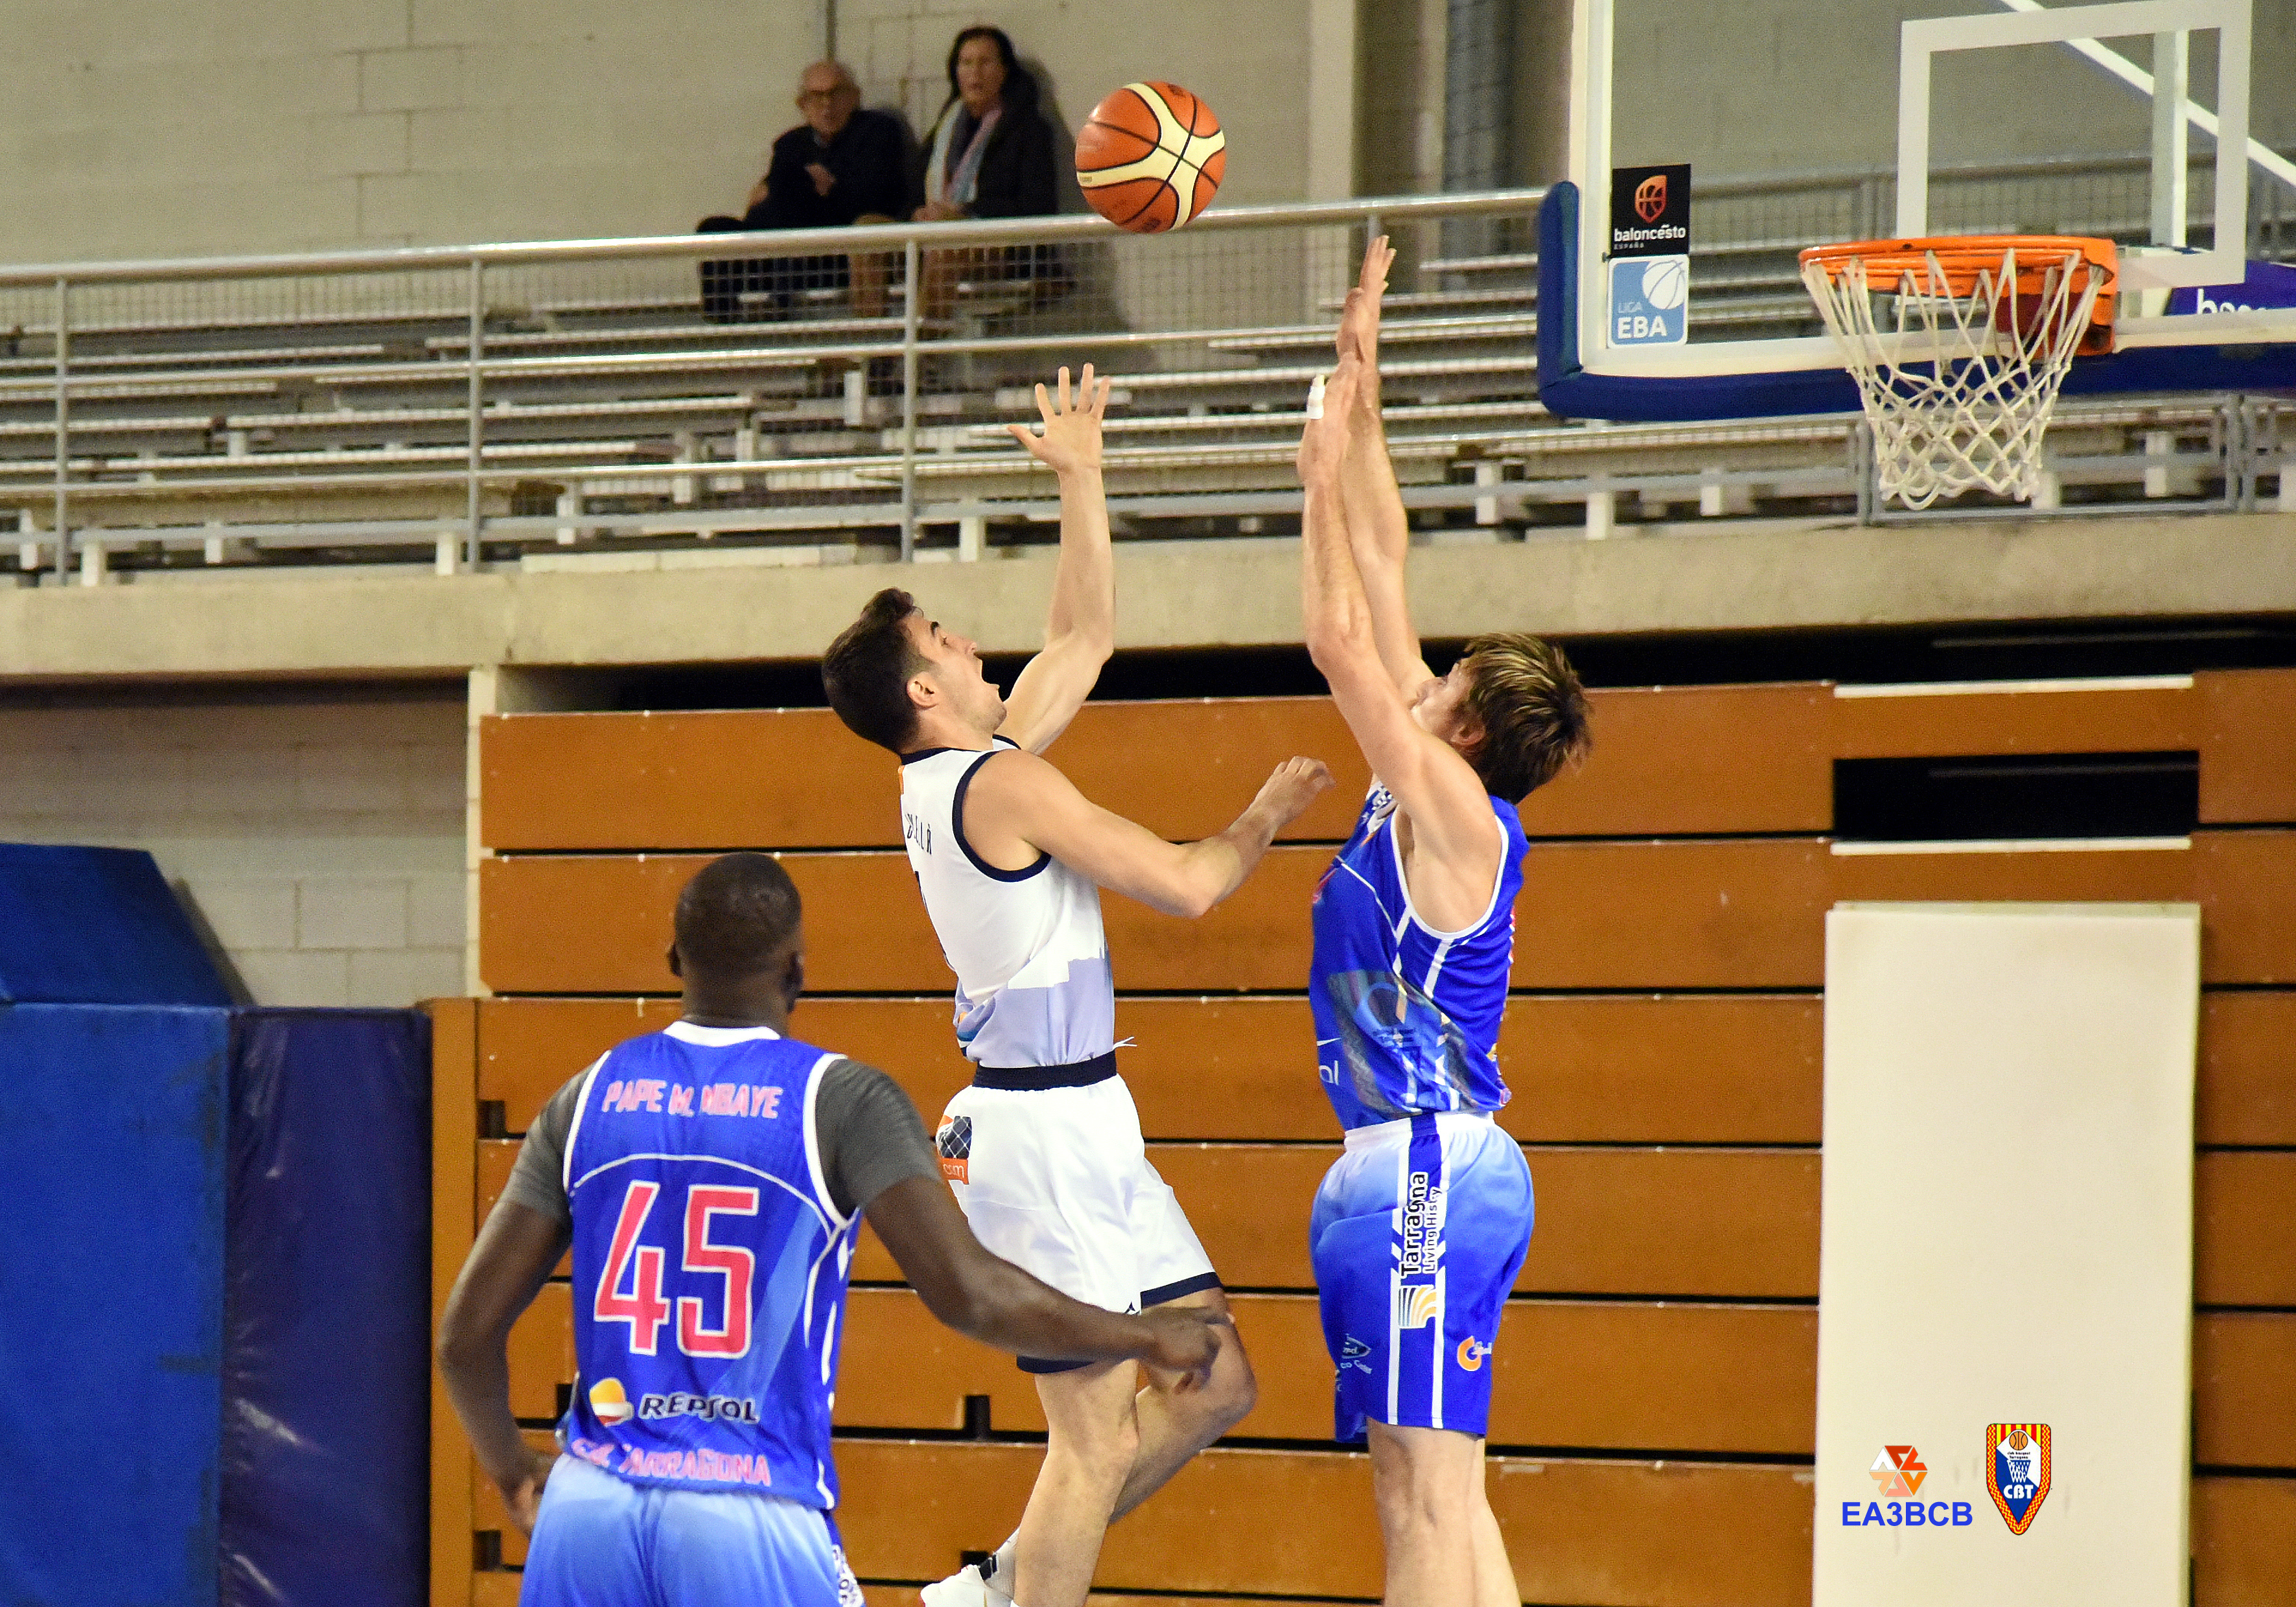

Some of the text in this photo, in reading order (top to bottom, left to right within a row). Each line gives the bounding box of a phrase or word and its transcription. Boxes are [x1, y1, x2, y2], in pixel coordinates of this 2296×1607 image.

[1614, 224, 1686, 242] baloncesto
[1618, 301, 1643, 313] LIGA
[1618, 315, 1667, 339] EBA
[601, 1079, 667, 1113] PAPE
[1424, 1231, 1437, 1272] Living
[594, 1179, 760, 1359] 45
[639, 1394, 760, 1424] REPSOL
